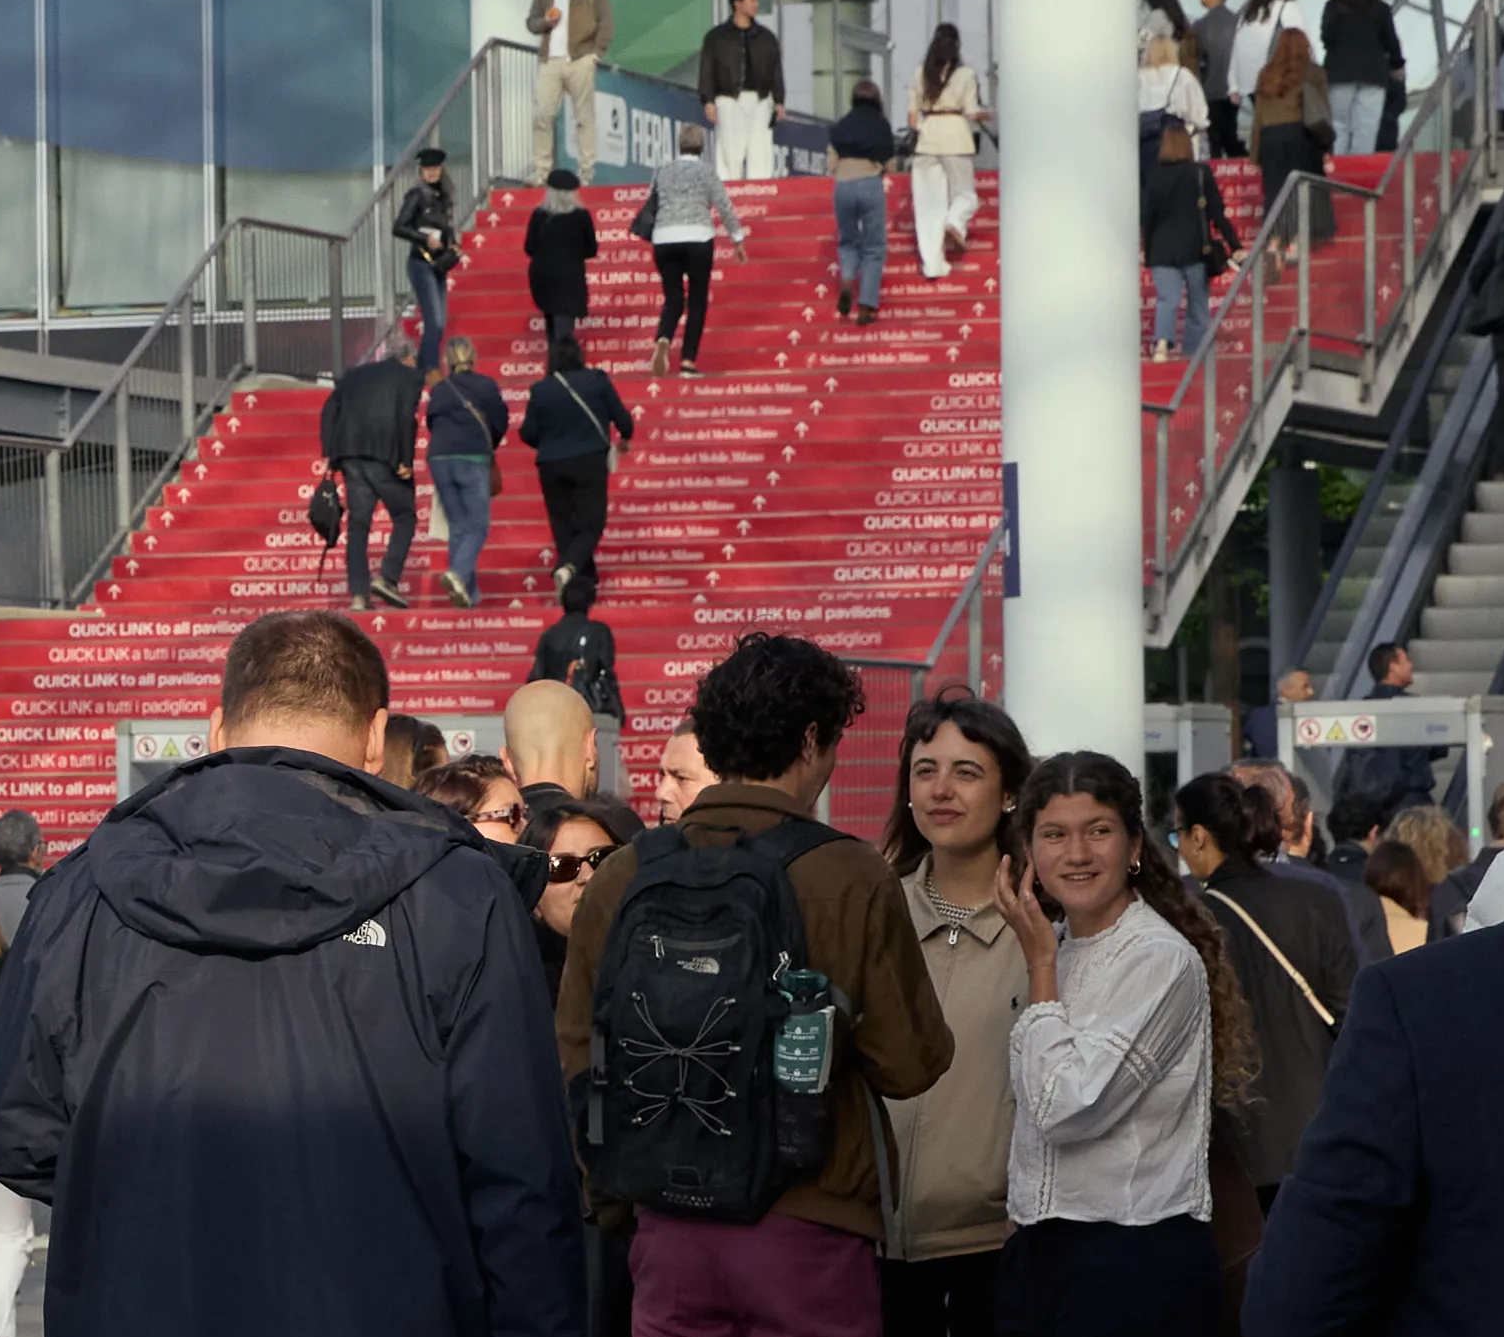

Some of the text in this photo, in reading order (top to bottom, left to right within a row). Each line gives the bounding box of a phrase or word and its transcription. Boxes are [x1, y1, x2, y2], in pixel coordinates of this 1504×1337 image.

[34, 672, 221, 689] QUICK LINK to all pavilions
[11, 700, 57, 716] QUICK
[61, 699, 92, 714] LINK
[95, 702, 105, 713] a
[107, 698, 131, 712] tutti
[142, 698, 206, 715] padiglioni
